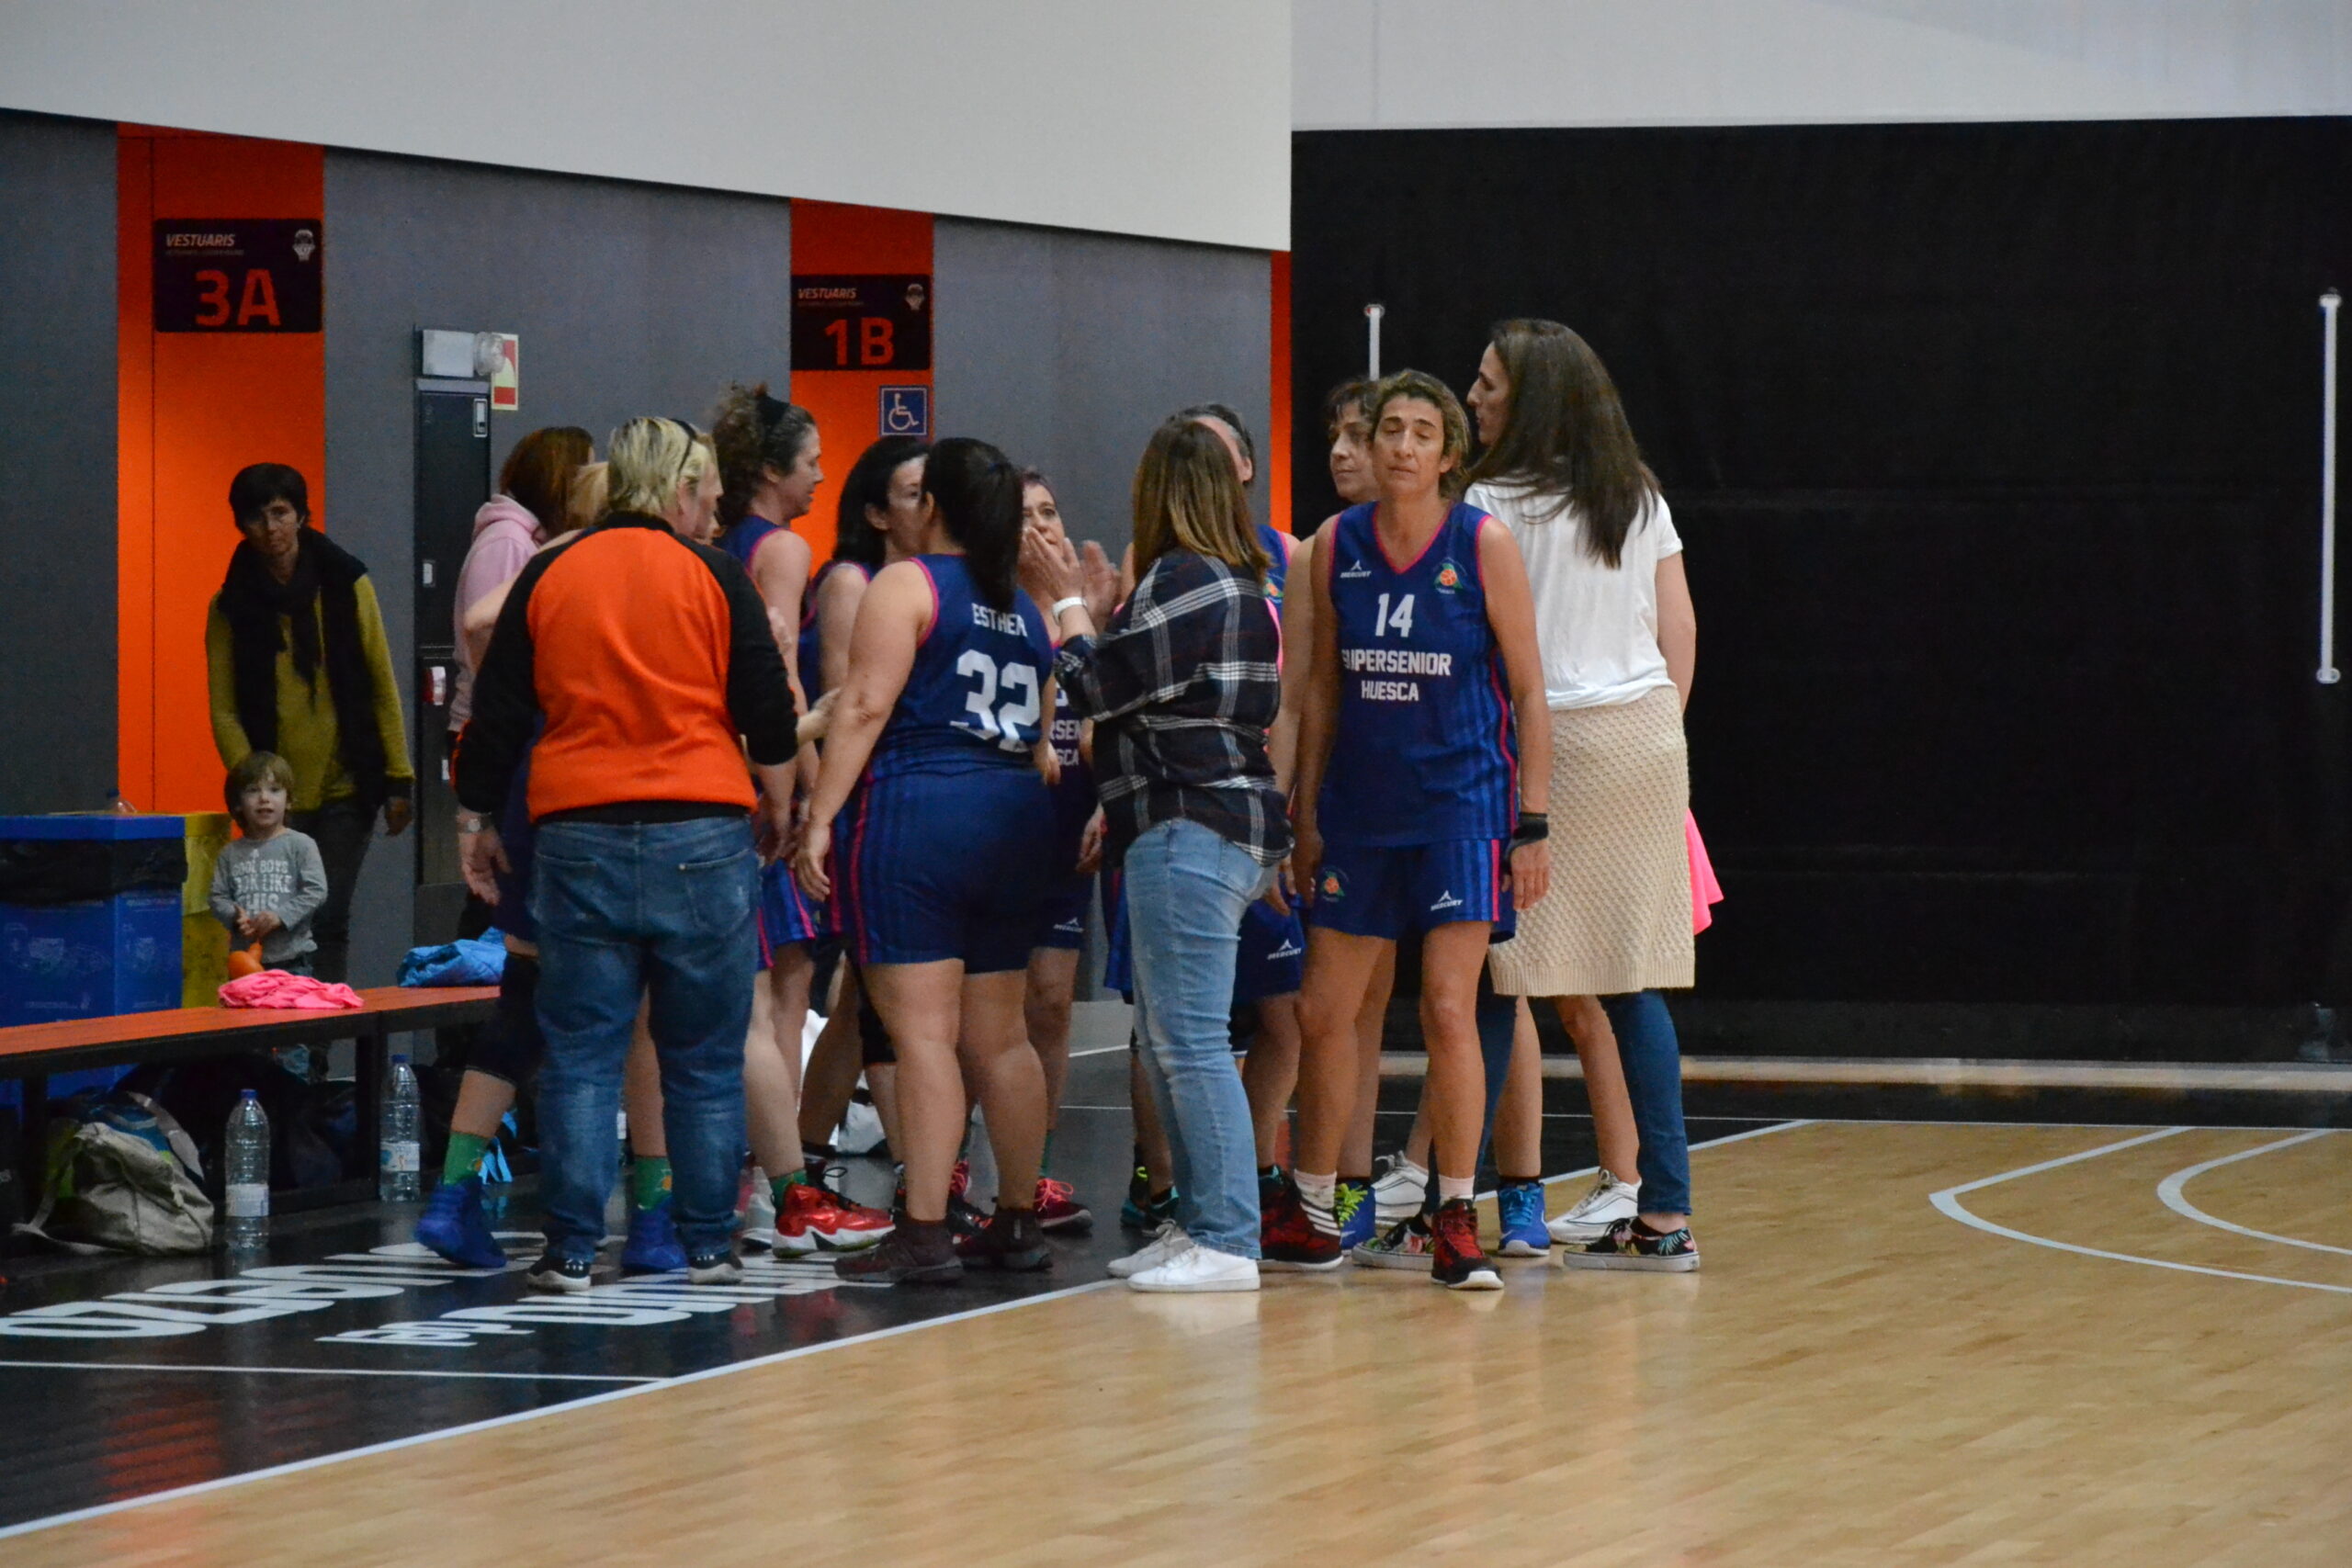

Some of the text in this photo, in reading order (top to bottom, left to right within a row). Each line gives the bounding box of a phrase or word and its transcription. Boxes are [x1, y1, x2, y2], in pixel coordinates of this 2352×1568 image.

[165, 233, 236, 248] VESTUARIS
[194, 268, 281, 327] 3A
[797, 288, 857, 299] VESTUARIS
[824, 316, 894, 366] 1B
[1374, 592, 1416, 637] 14
[950, 649, 1041, 753] 32
[1361, 680, 1419, 702] HUESCA
[259, 859, 289, 874] BOYS
[262, 874, 292, 894] LIKE
